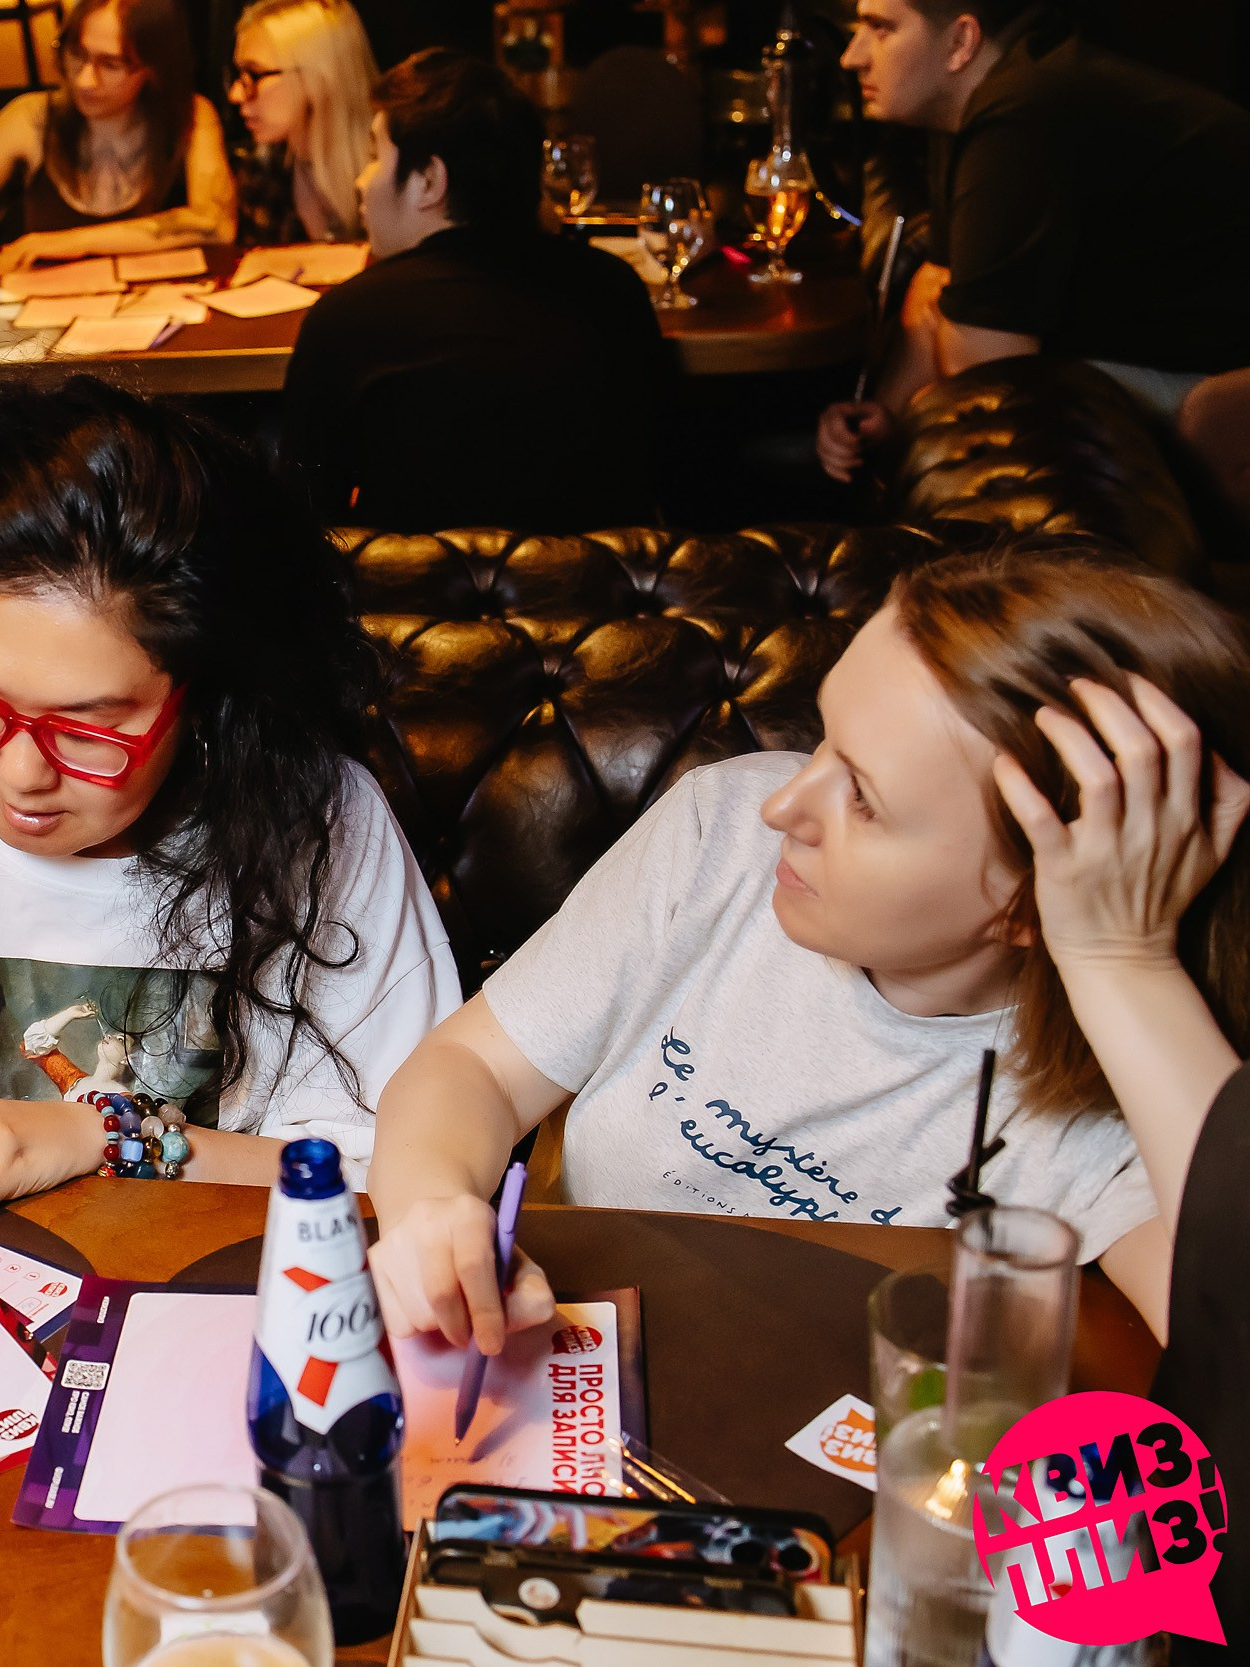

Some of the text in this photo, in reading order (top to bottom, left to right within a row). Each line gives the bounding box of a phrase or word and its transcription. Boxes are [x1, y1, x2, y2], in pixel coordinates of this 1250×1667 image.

[705, 1099, 859, 1205] mystère
[297, 1212, 358, 1242] BLAN
[307, 1298, 379, 1343] 166
[548, 1363, 577, 1403] ДЛЯ
[579, 1364, 606, 1497] ПРОСТО ЛИС
